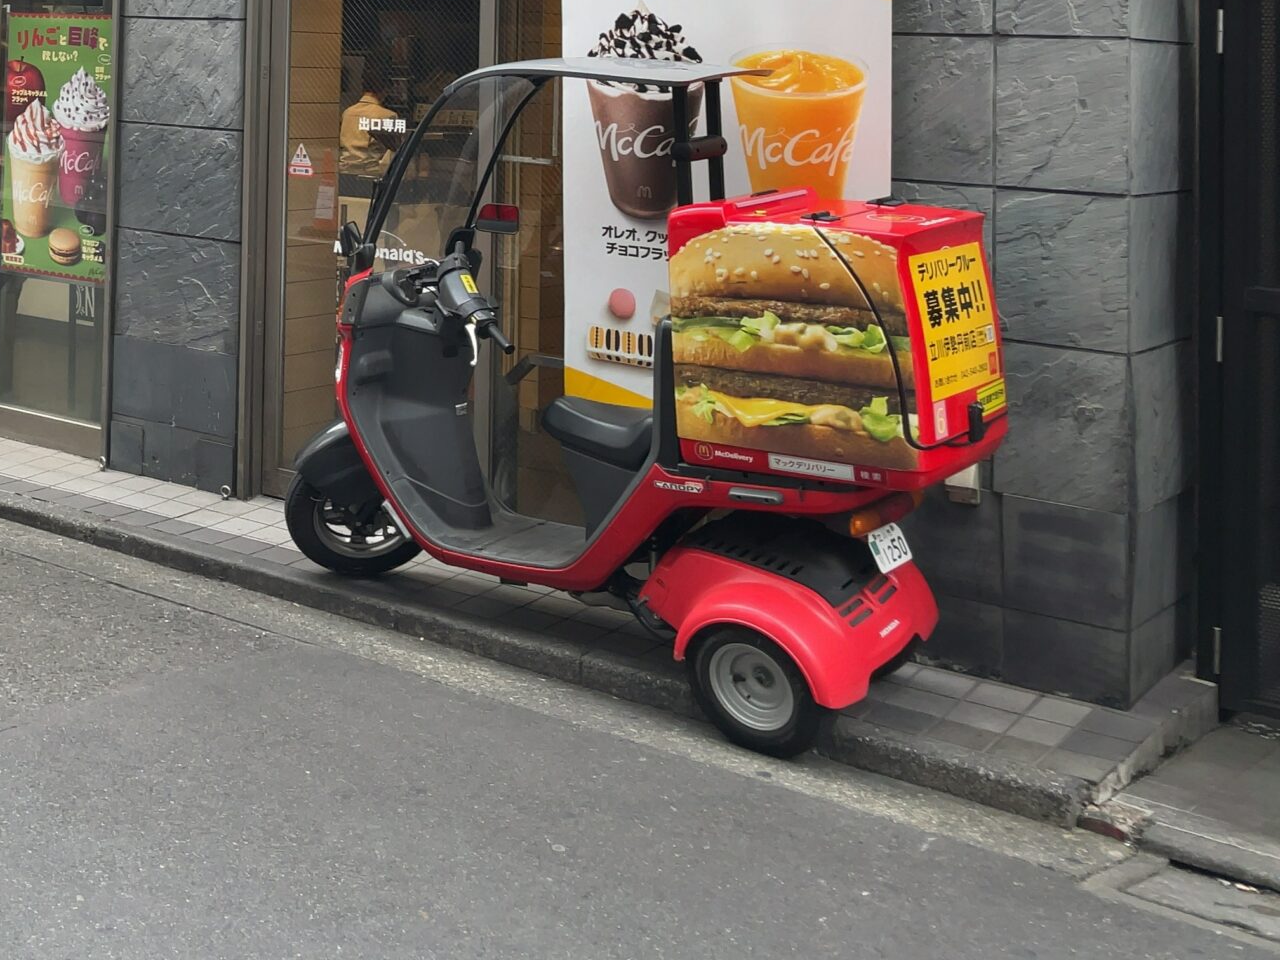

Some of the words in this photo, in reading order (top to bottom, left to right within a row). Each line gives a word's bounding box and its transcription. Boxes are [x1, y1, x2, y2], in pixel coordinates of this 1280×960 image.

[358, 117, 407, 133] 出口専用
[917, 254, 976, 282] デリバリークルー
[714, 449, 754, 463] McDelivery
[773, 457, 835, 474] マックデリバリー
[883, 536, 908, 565] 1250
